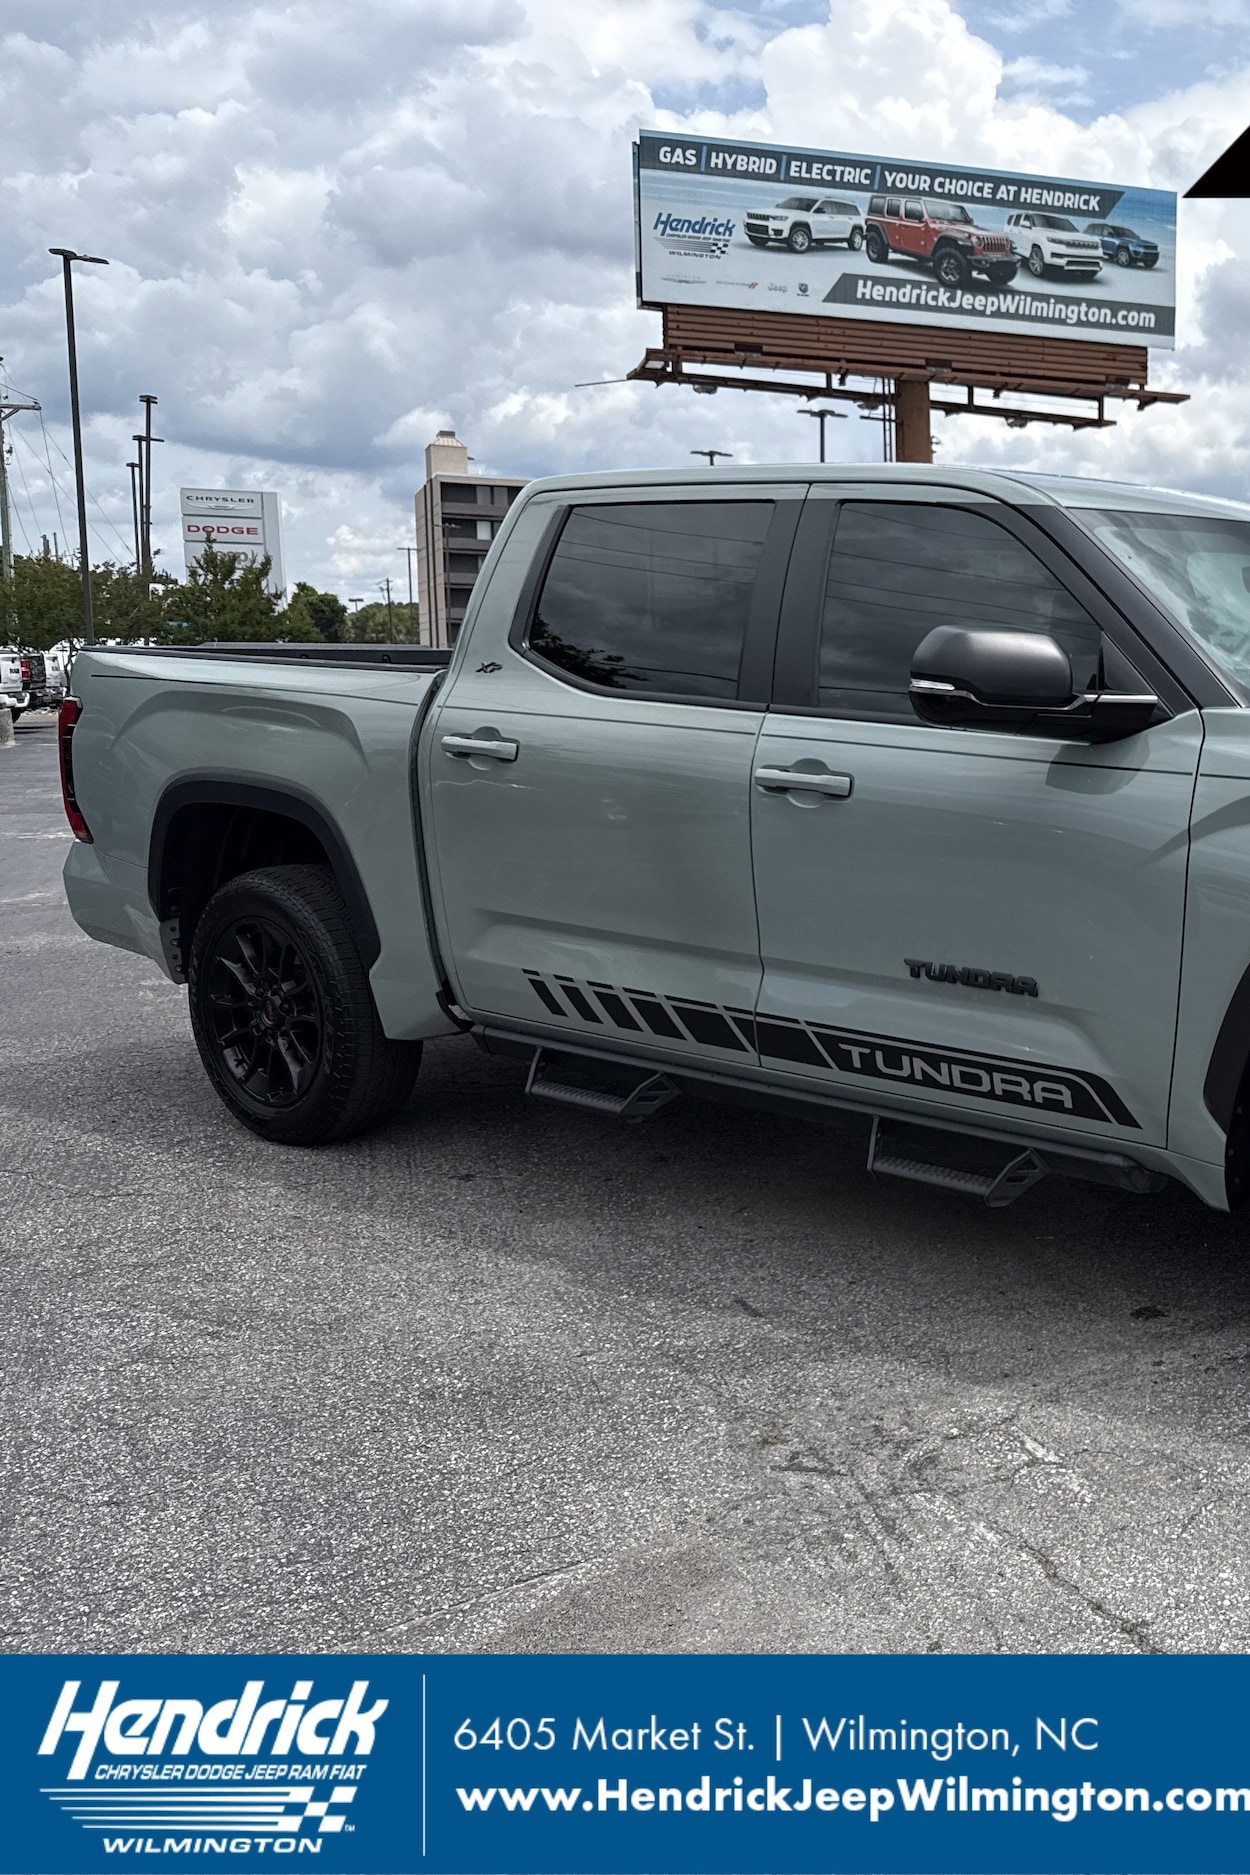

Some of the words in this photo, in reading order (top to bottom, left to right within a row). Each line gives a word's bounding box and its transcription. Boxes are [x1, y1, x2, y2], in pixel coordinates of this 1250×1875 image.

[658, 146, 698, 166] GAS
[710, 151, 778, 175] HYBRID
[789, 161, 872, 185] ELECTRIC
[884, 170, 931, 192] YOUR
[933, 176, 994, 199] CHOICE
[996, 184, 1018, 201] AT
[1019, 187, 1101, 212] HENDRICK
[653, 212, 736, 238] Hendrick
[668, 250, 722, 260] WILMINGTON
[856, 279, 1156, 329] HendrickJeepWilmington.com
[186, 495, 255, 503] CHRYSLER
[187, 525, 259, 535] DODGE
[904, 958, 1039, 998] TUNDRA
[838, 1043, 1074, 1109] TUNDRA
